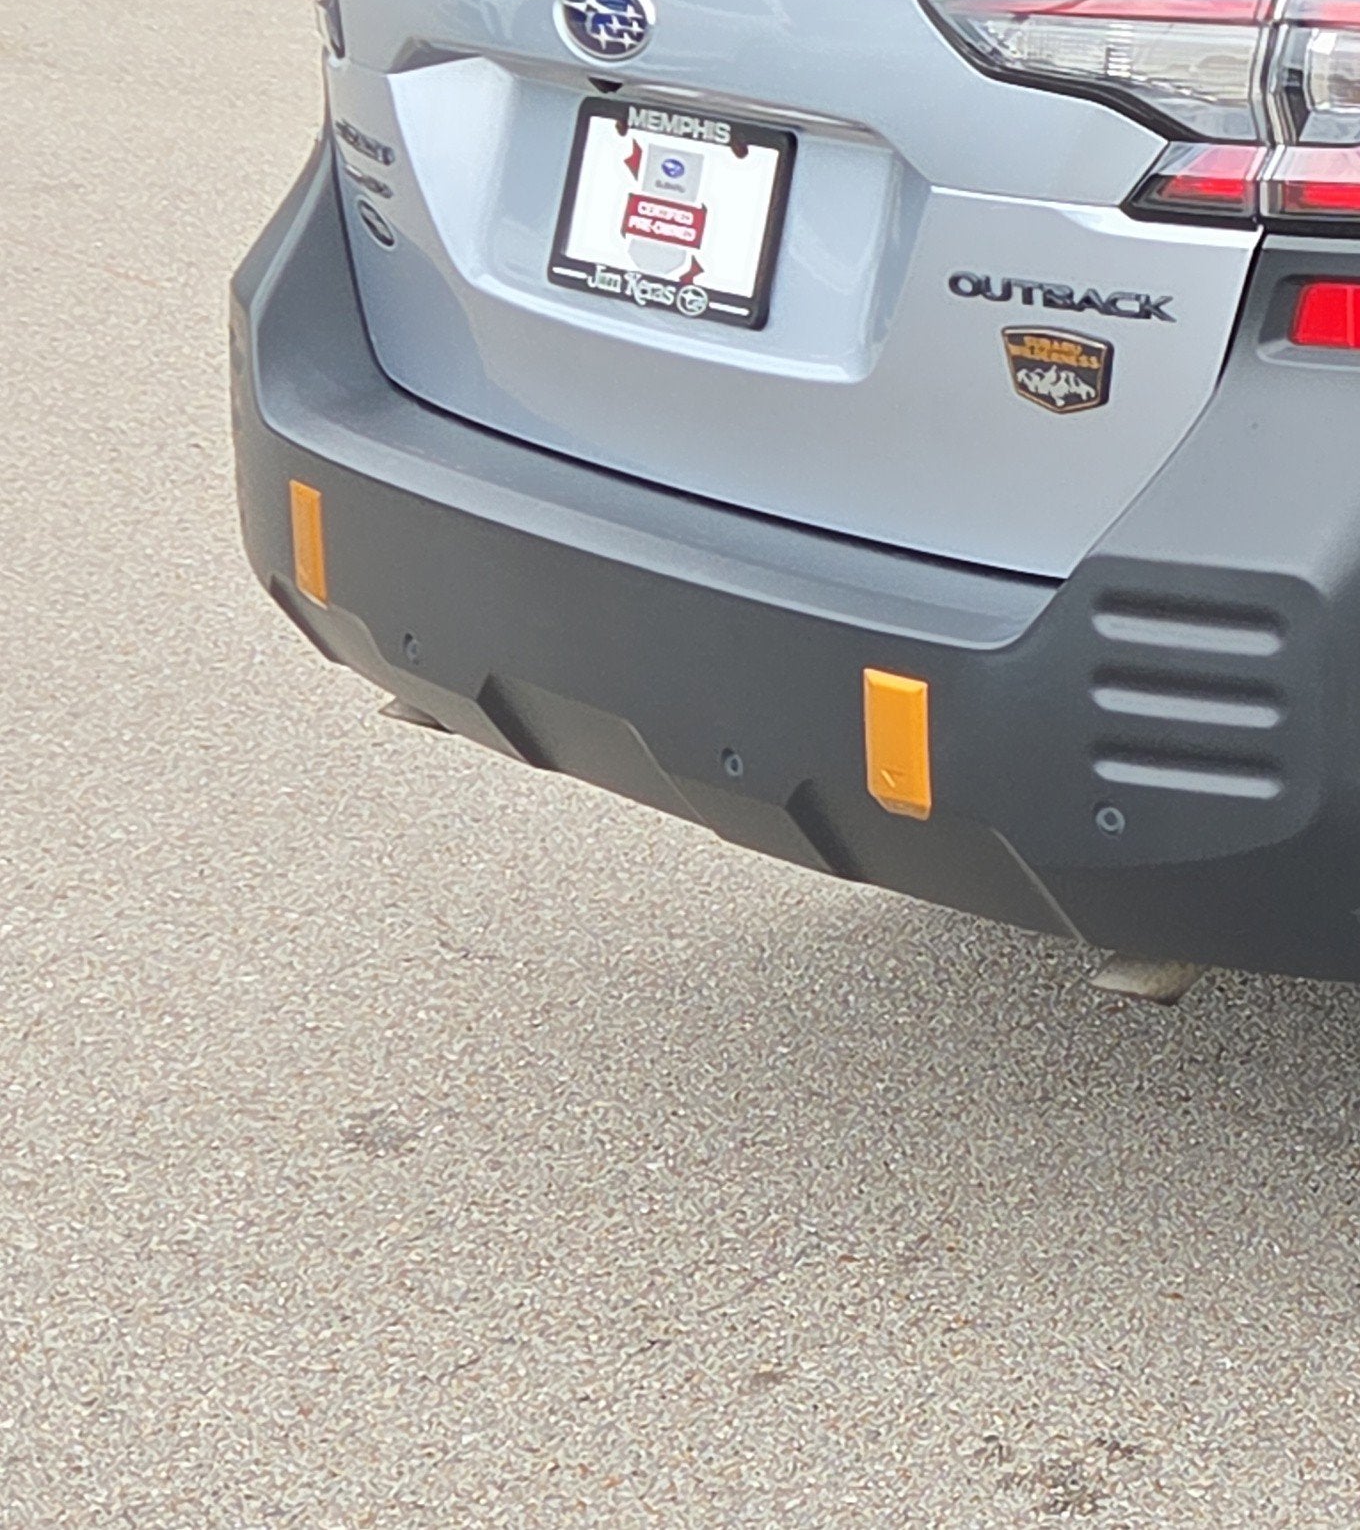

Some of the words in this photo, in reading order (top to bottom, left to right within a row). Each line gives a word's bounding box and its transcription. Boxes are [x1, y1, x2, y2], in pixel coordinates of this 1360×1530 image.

[628, 105, 732, 144] MEMPHIS
[586, 265, 622, 294] Jim
[624, 271, 677, 307] Keras
[948, 270, 1178, 323] OUTBACK
